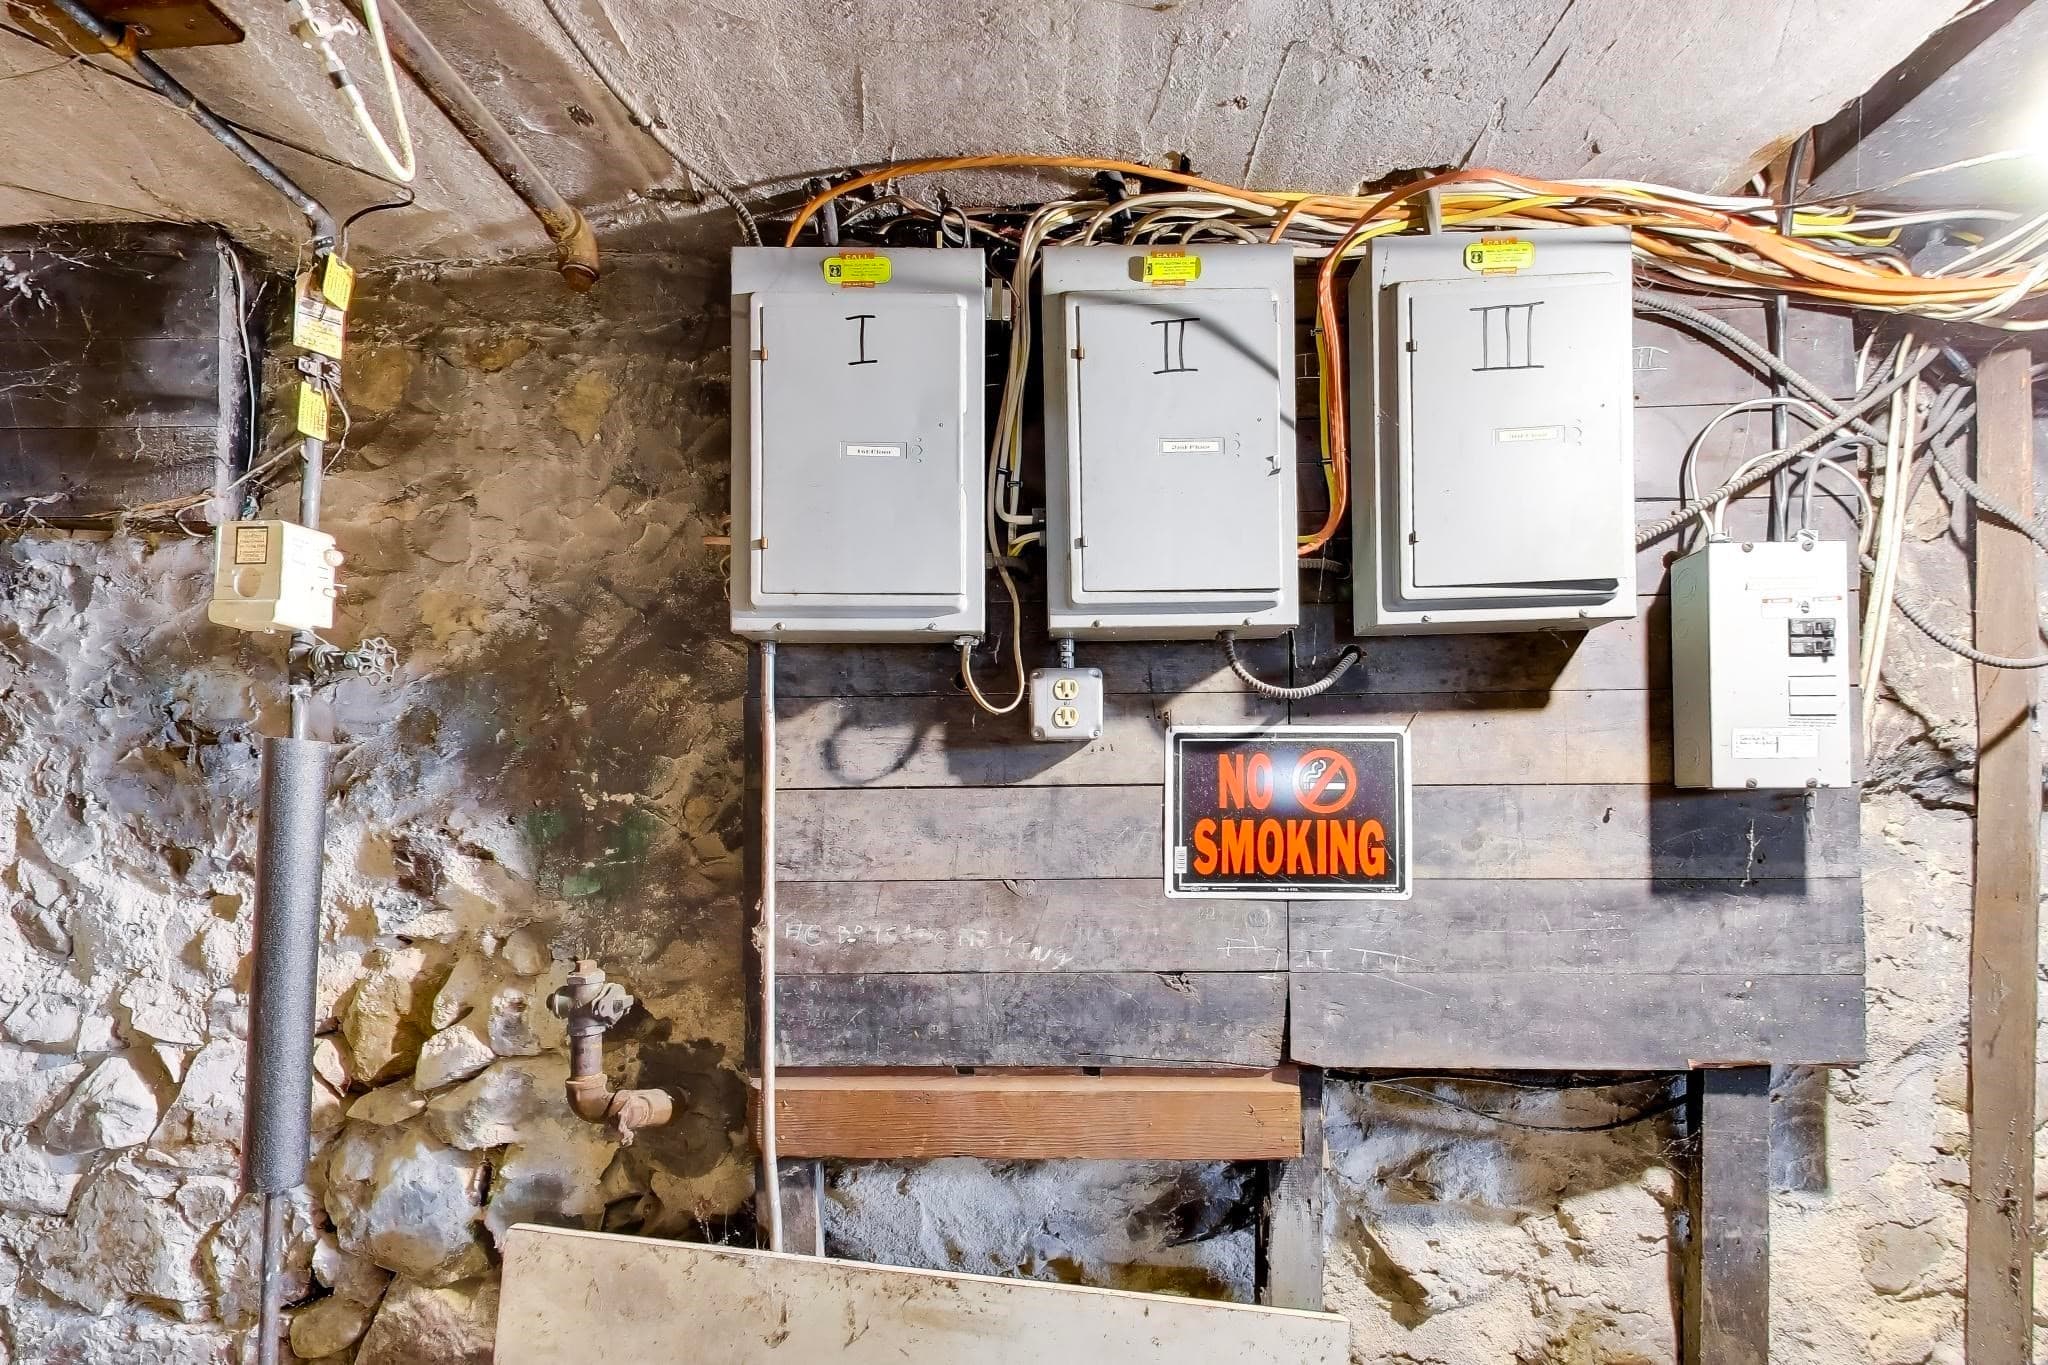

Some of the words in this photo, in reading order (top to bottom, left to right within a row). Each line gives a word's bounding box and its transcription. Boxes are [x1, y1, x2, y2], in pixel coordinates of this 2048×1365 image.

[845, 314, 878, 366] I
[1150, 318, 1200, 375] II
[1469, 301, 1545, 371] III
[1218, 752, 1273, 810] NO
[1193, 818, 1385, 877] SMOKING
